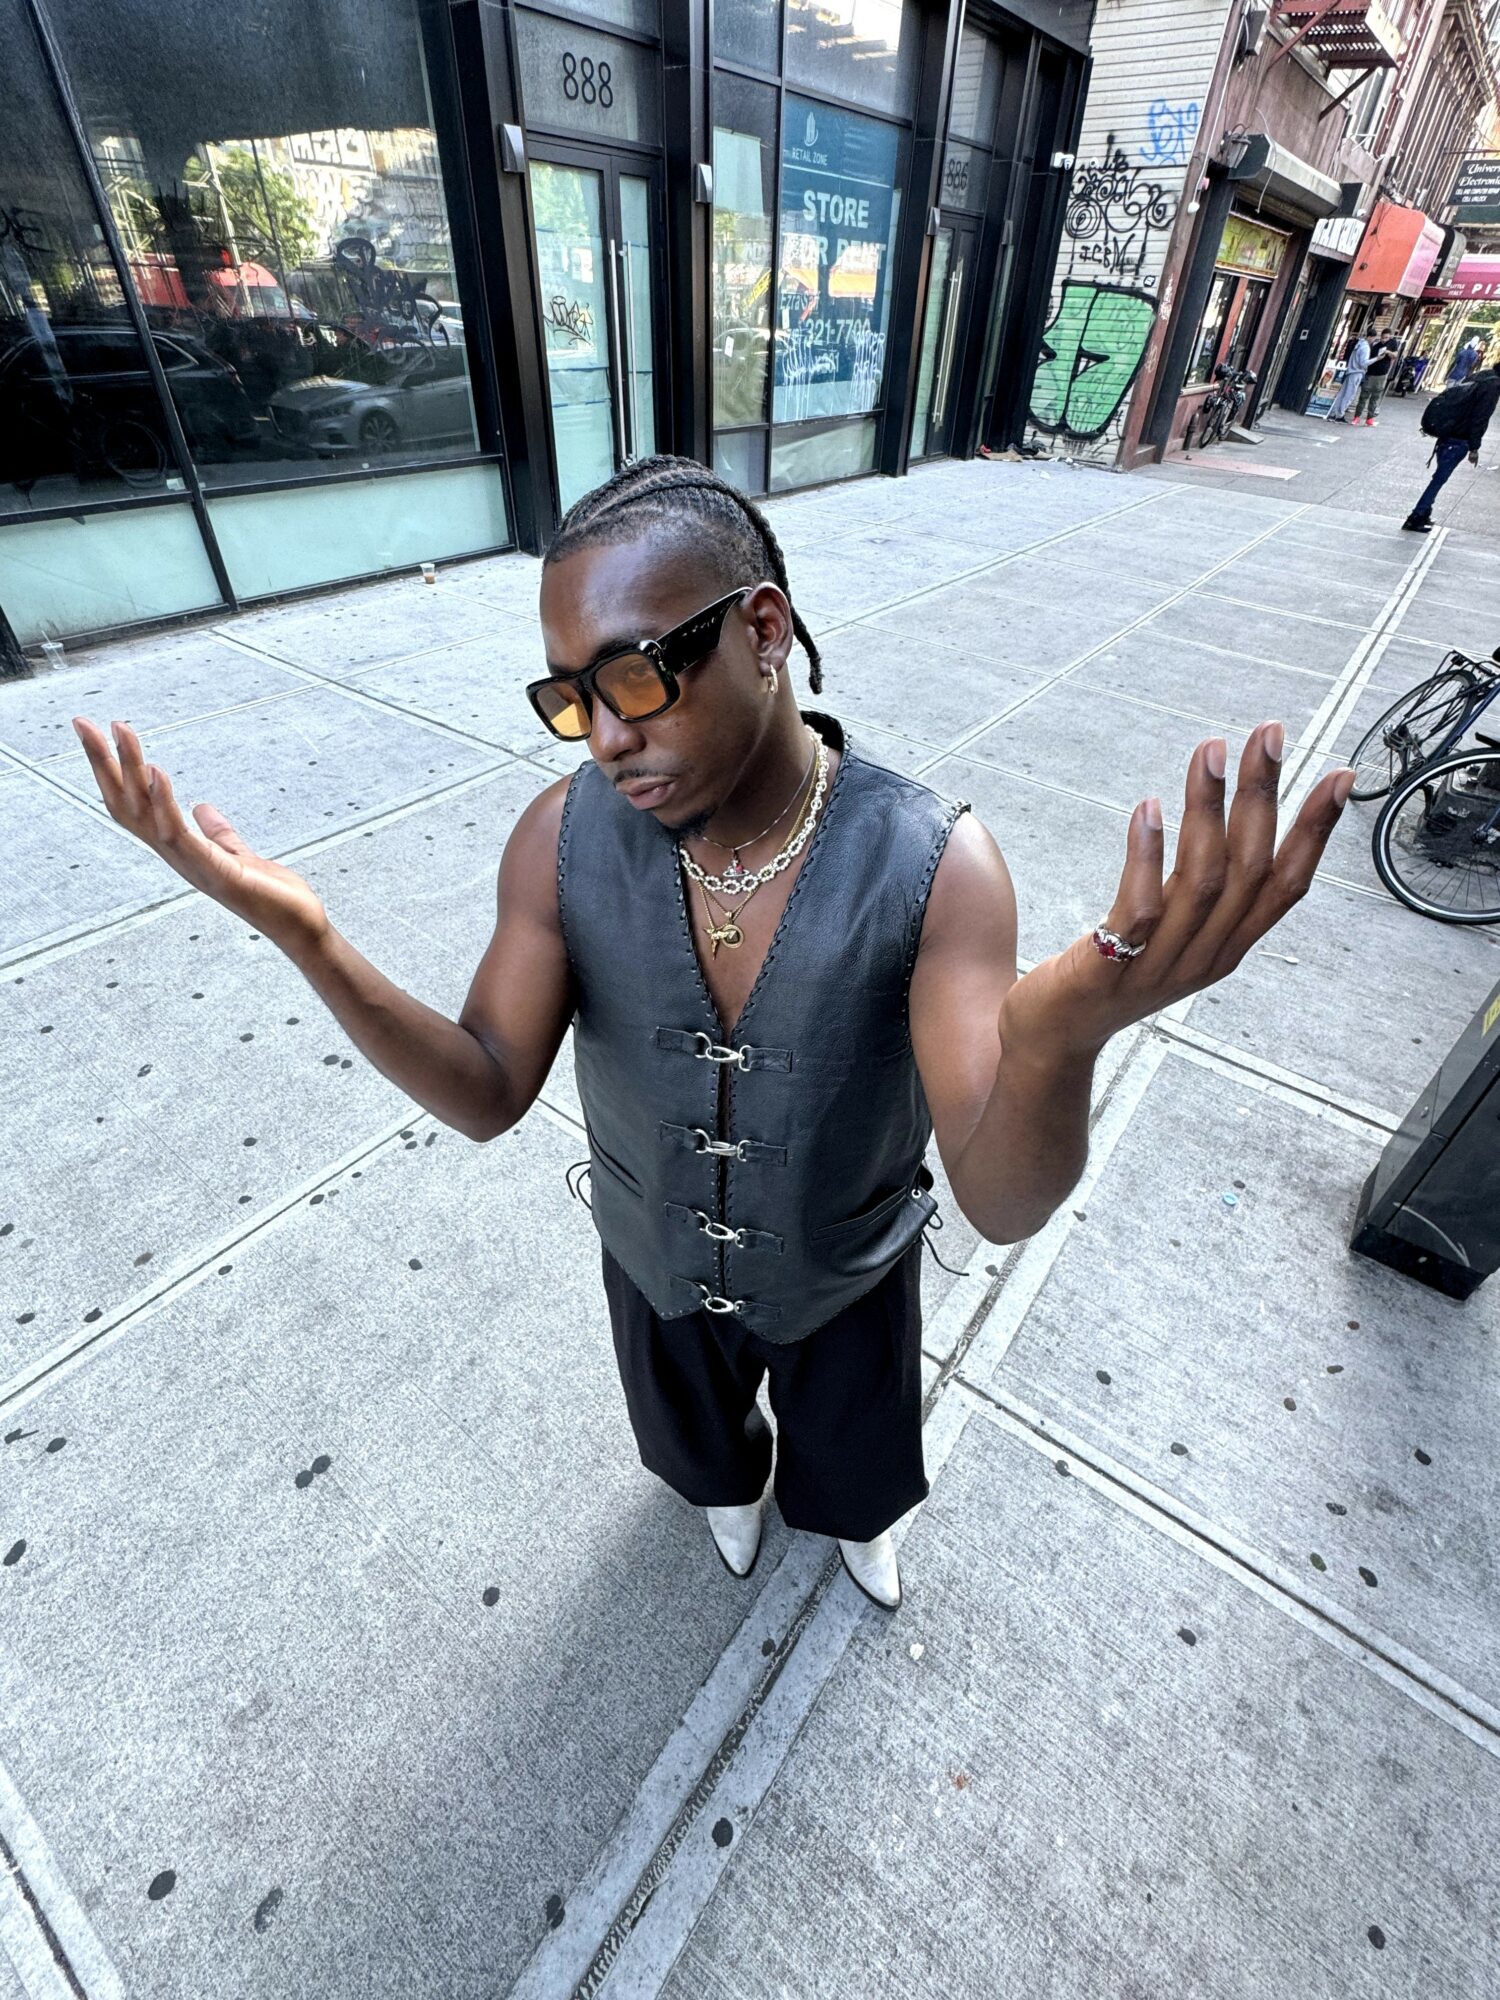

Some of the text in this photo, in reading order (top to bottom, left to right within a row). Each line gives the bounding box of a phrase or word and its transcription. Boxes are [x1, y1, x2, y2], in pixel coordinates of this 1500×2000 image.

[562, 52, 614, 108] 888
[791, 147, 829, 166] RETAIL ZONE
[947, 158, 968, 190] 886
[803, 190, 870, 229] STORE
[1423, 306, 1443, 315] ATM
